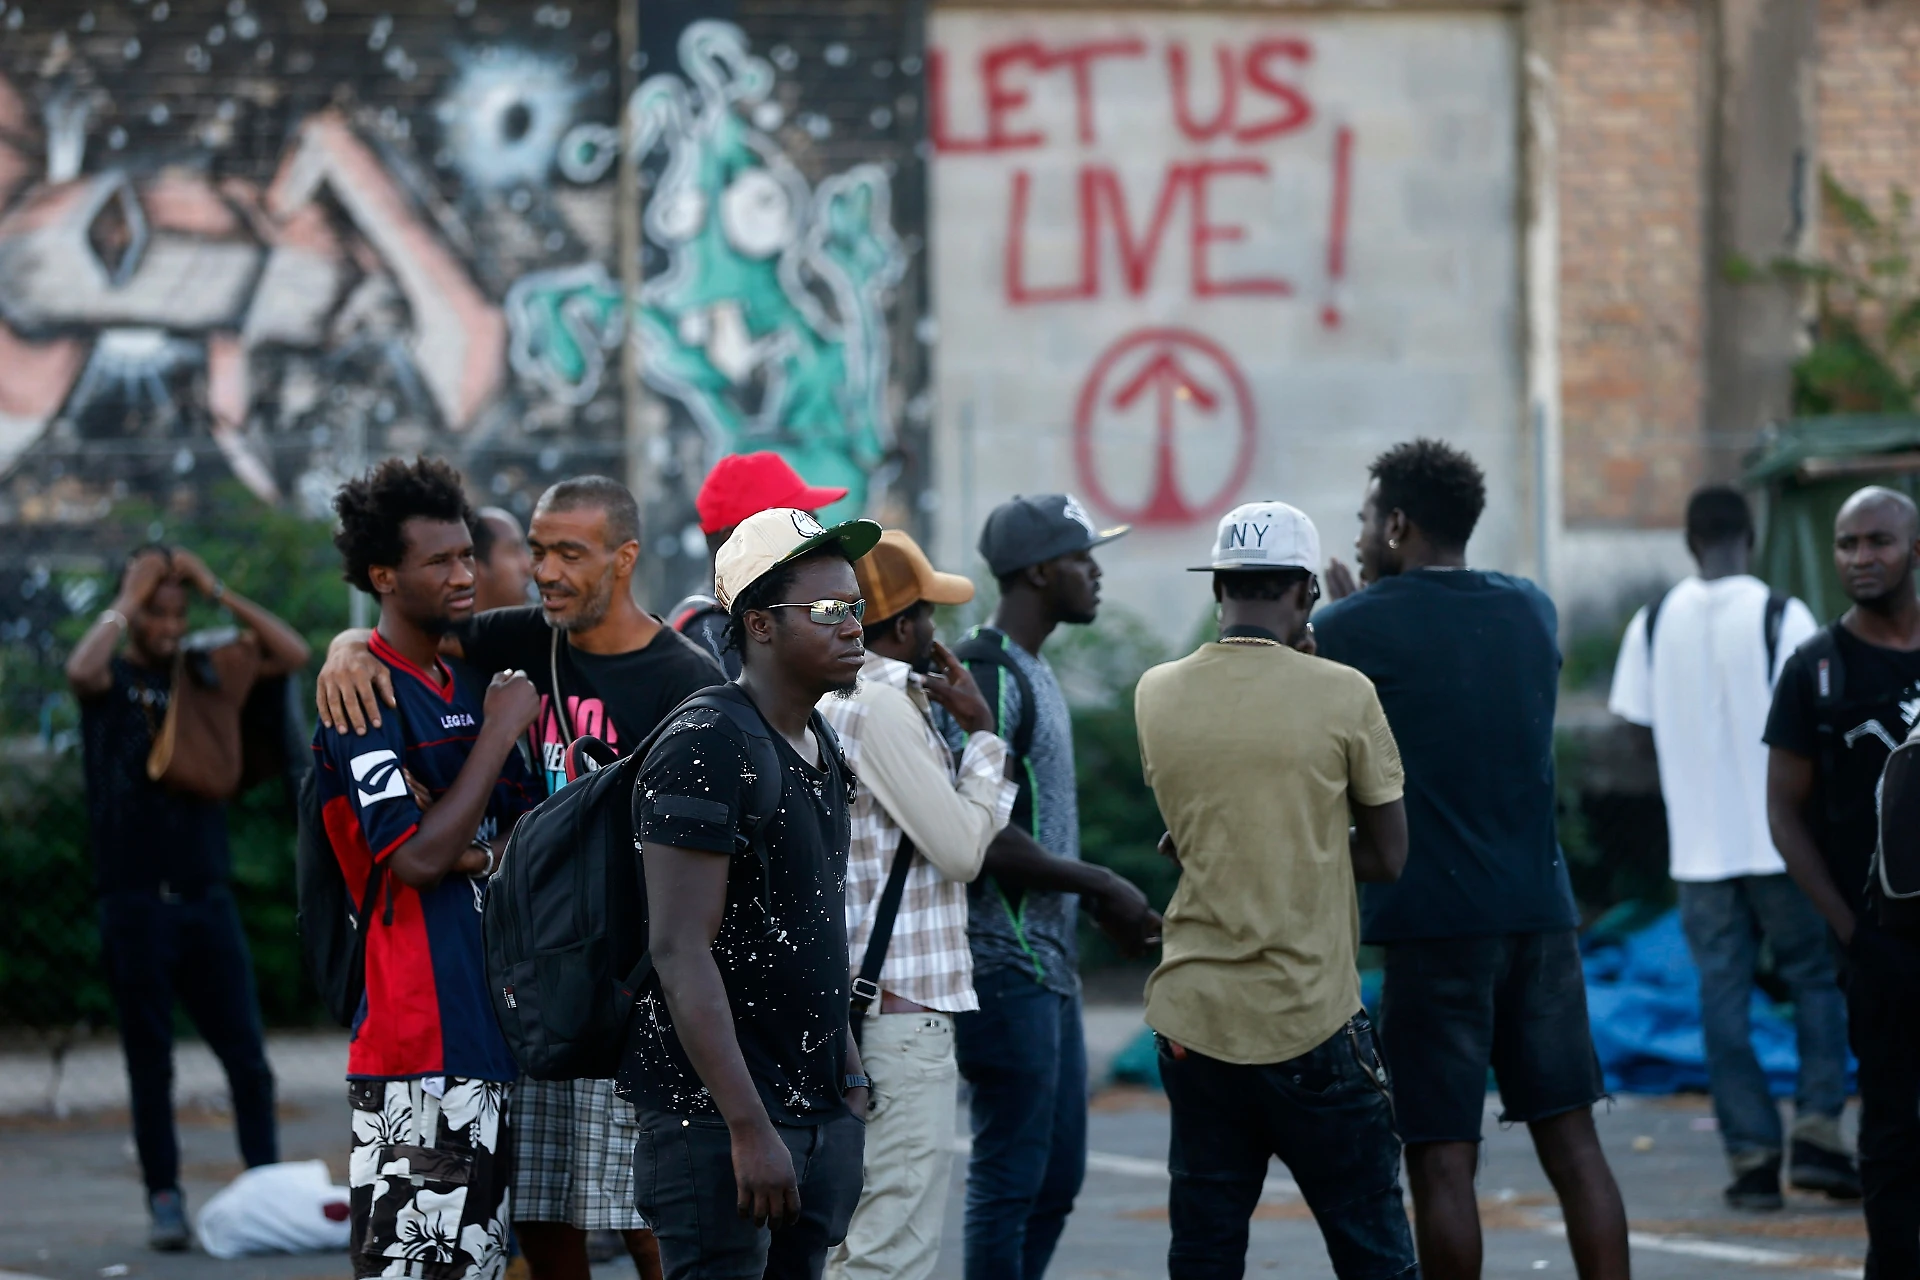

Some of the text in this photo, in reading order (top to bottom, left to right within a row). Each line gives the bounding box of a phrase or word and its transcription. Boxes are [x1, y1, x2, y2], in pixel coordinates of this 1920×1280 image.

[928, 37, 1314, 154] LET US
[1006, 158, 1291, 305] LIVE
[1230, 522, 1270, 548] NY
[440, 713, 475, 729] LEGEA
